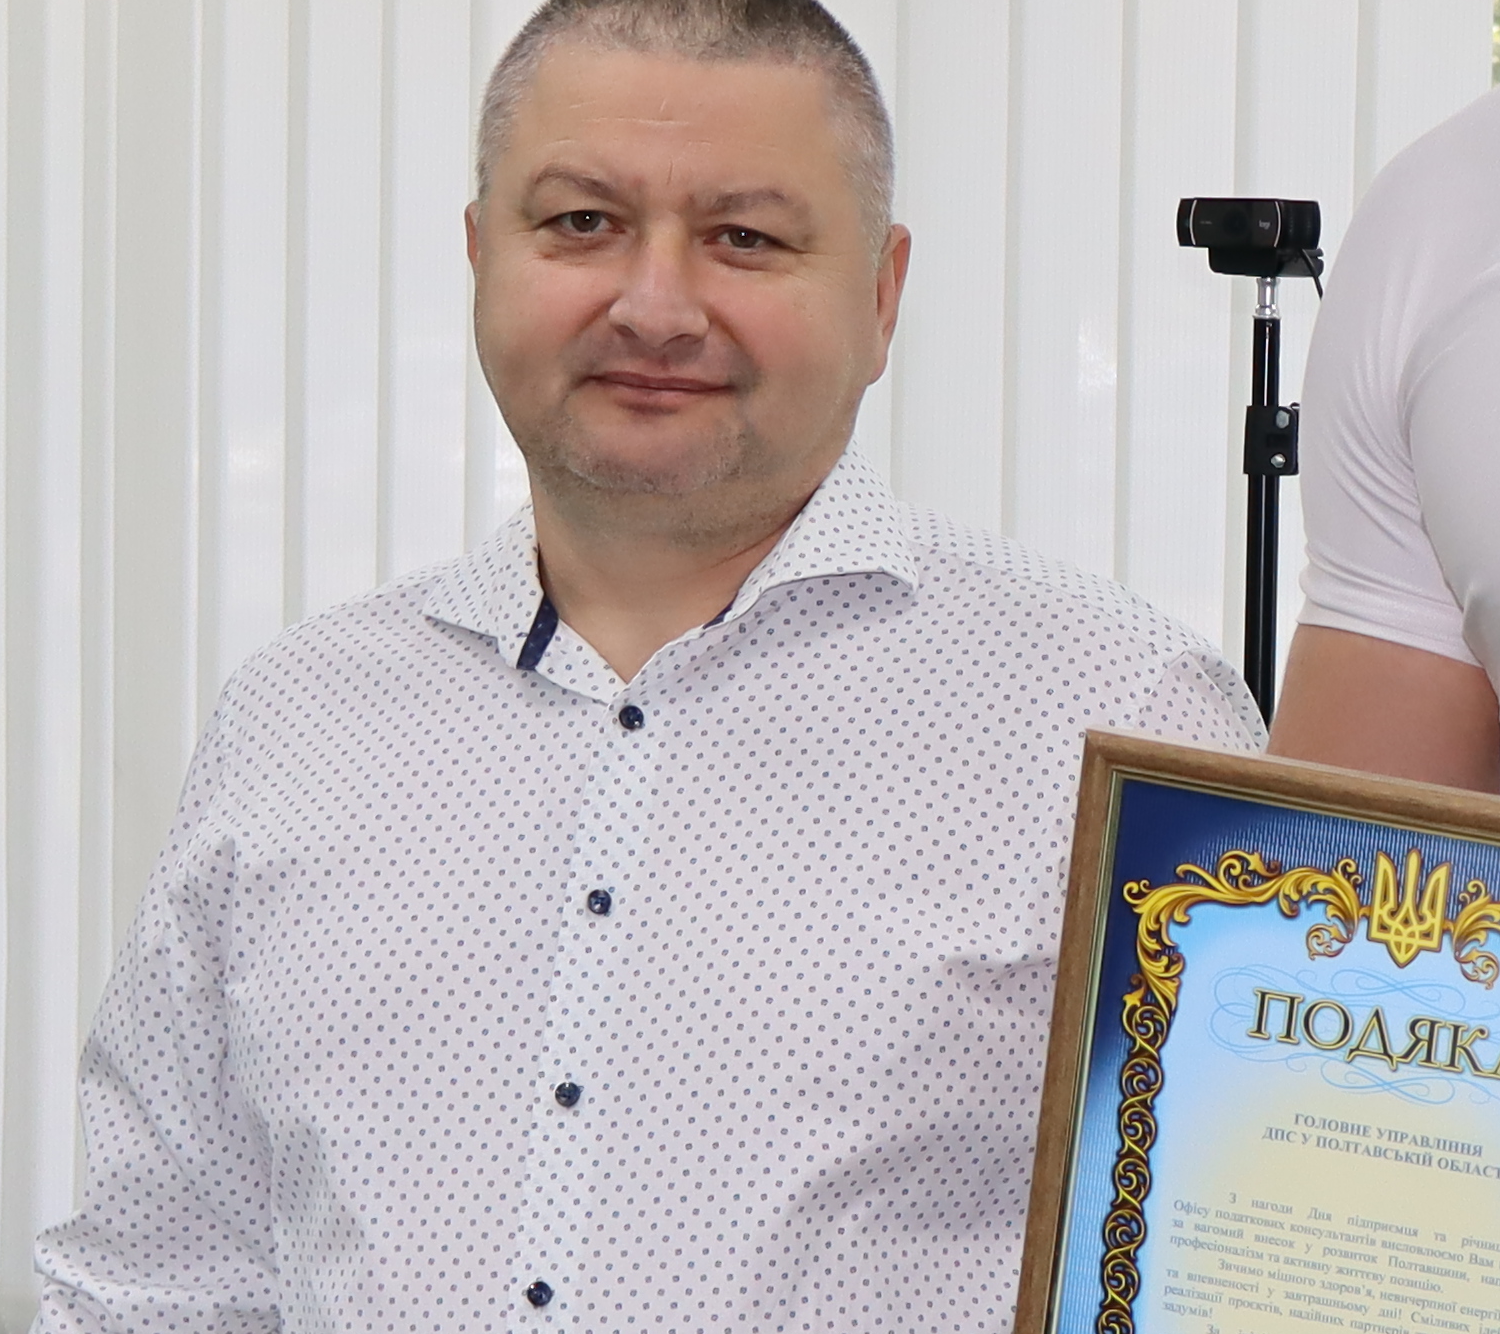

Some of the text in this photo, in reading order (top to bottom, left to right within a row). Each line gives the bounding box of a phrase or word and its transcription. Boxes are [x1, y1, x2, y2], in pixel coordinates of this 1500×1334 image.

[1261, 1126, 1298, 1144] ДПС
[1301, 1132, 1313, 1146] У
[1315, 1135, 1434, 1168] ПОЛТАВСЬКІЙ
[1293, 1112, 1484, 1158] ГОЛОВНЕ УПРАВЛІННЯ
[1172, 1198, 1212, 1220] Офісу
[1214, 1209, 1286, 1231] податкових
[1289, 1223, 1377, 1247] консультантів
[1467, 1252, 1495, 1269] Вам
[1228, 1191, 1238, 1205] З
[1250, 1198, 1294, 1215] нагоди
[1306, 1206, 1333, 1223] Дня
[1433, 1231, 1447, 1243] та
[1169, 1234, 1265, 1261] професіоналізм
[1266, 1252, 1281, 1264] та
[1282, 1255, 1333, 1276] активну
[1171, 1218, 1185, 1230] за
[1192, 1222, 1245, 1240] вагомий
[1253, 1233, 1296, 1250] внесок
[1303, 1242, 1314, 1255] у
[1321, 1245, 1379, 1265] розвиток
[1165, 1268, 1180, 1280] та
[1265, 1286, 1276, 1300] у
[1282, 1290, 1371, 1317] завтрашньому
[1377, 1307, 1403, 1321] дні!
[1409, 1310, 1471, 1334] Сміливих
[1217, 1257, 1265, 1278] Зичимо
[1267, 1268, 1317, 1288] міцного
[1379, 1290, 1459, 1314] невичерпної
[1162, 1301, 1214, 1320] задумів!
